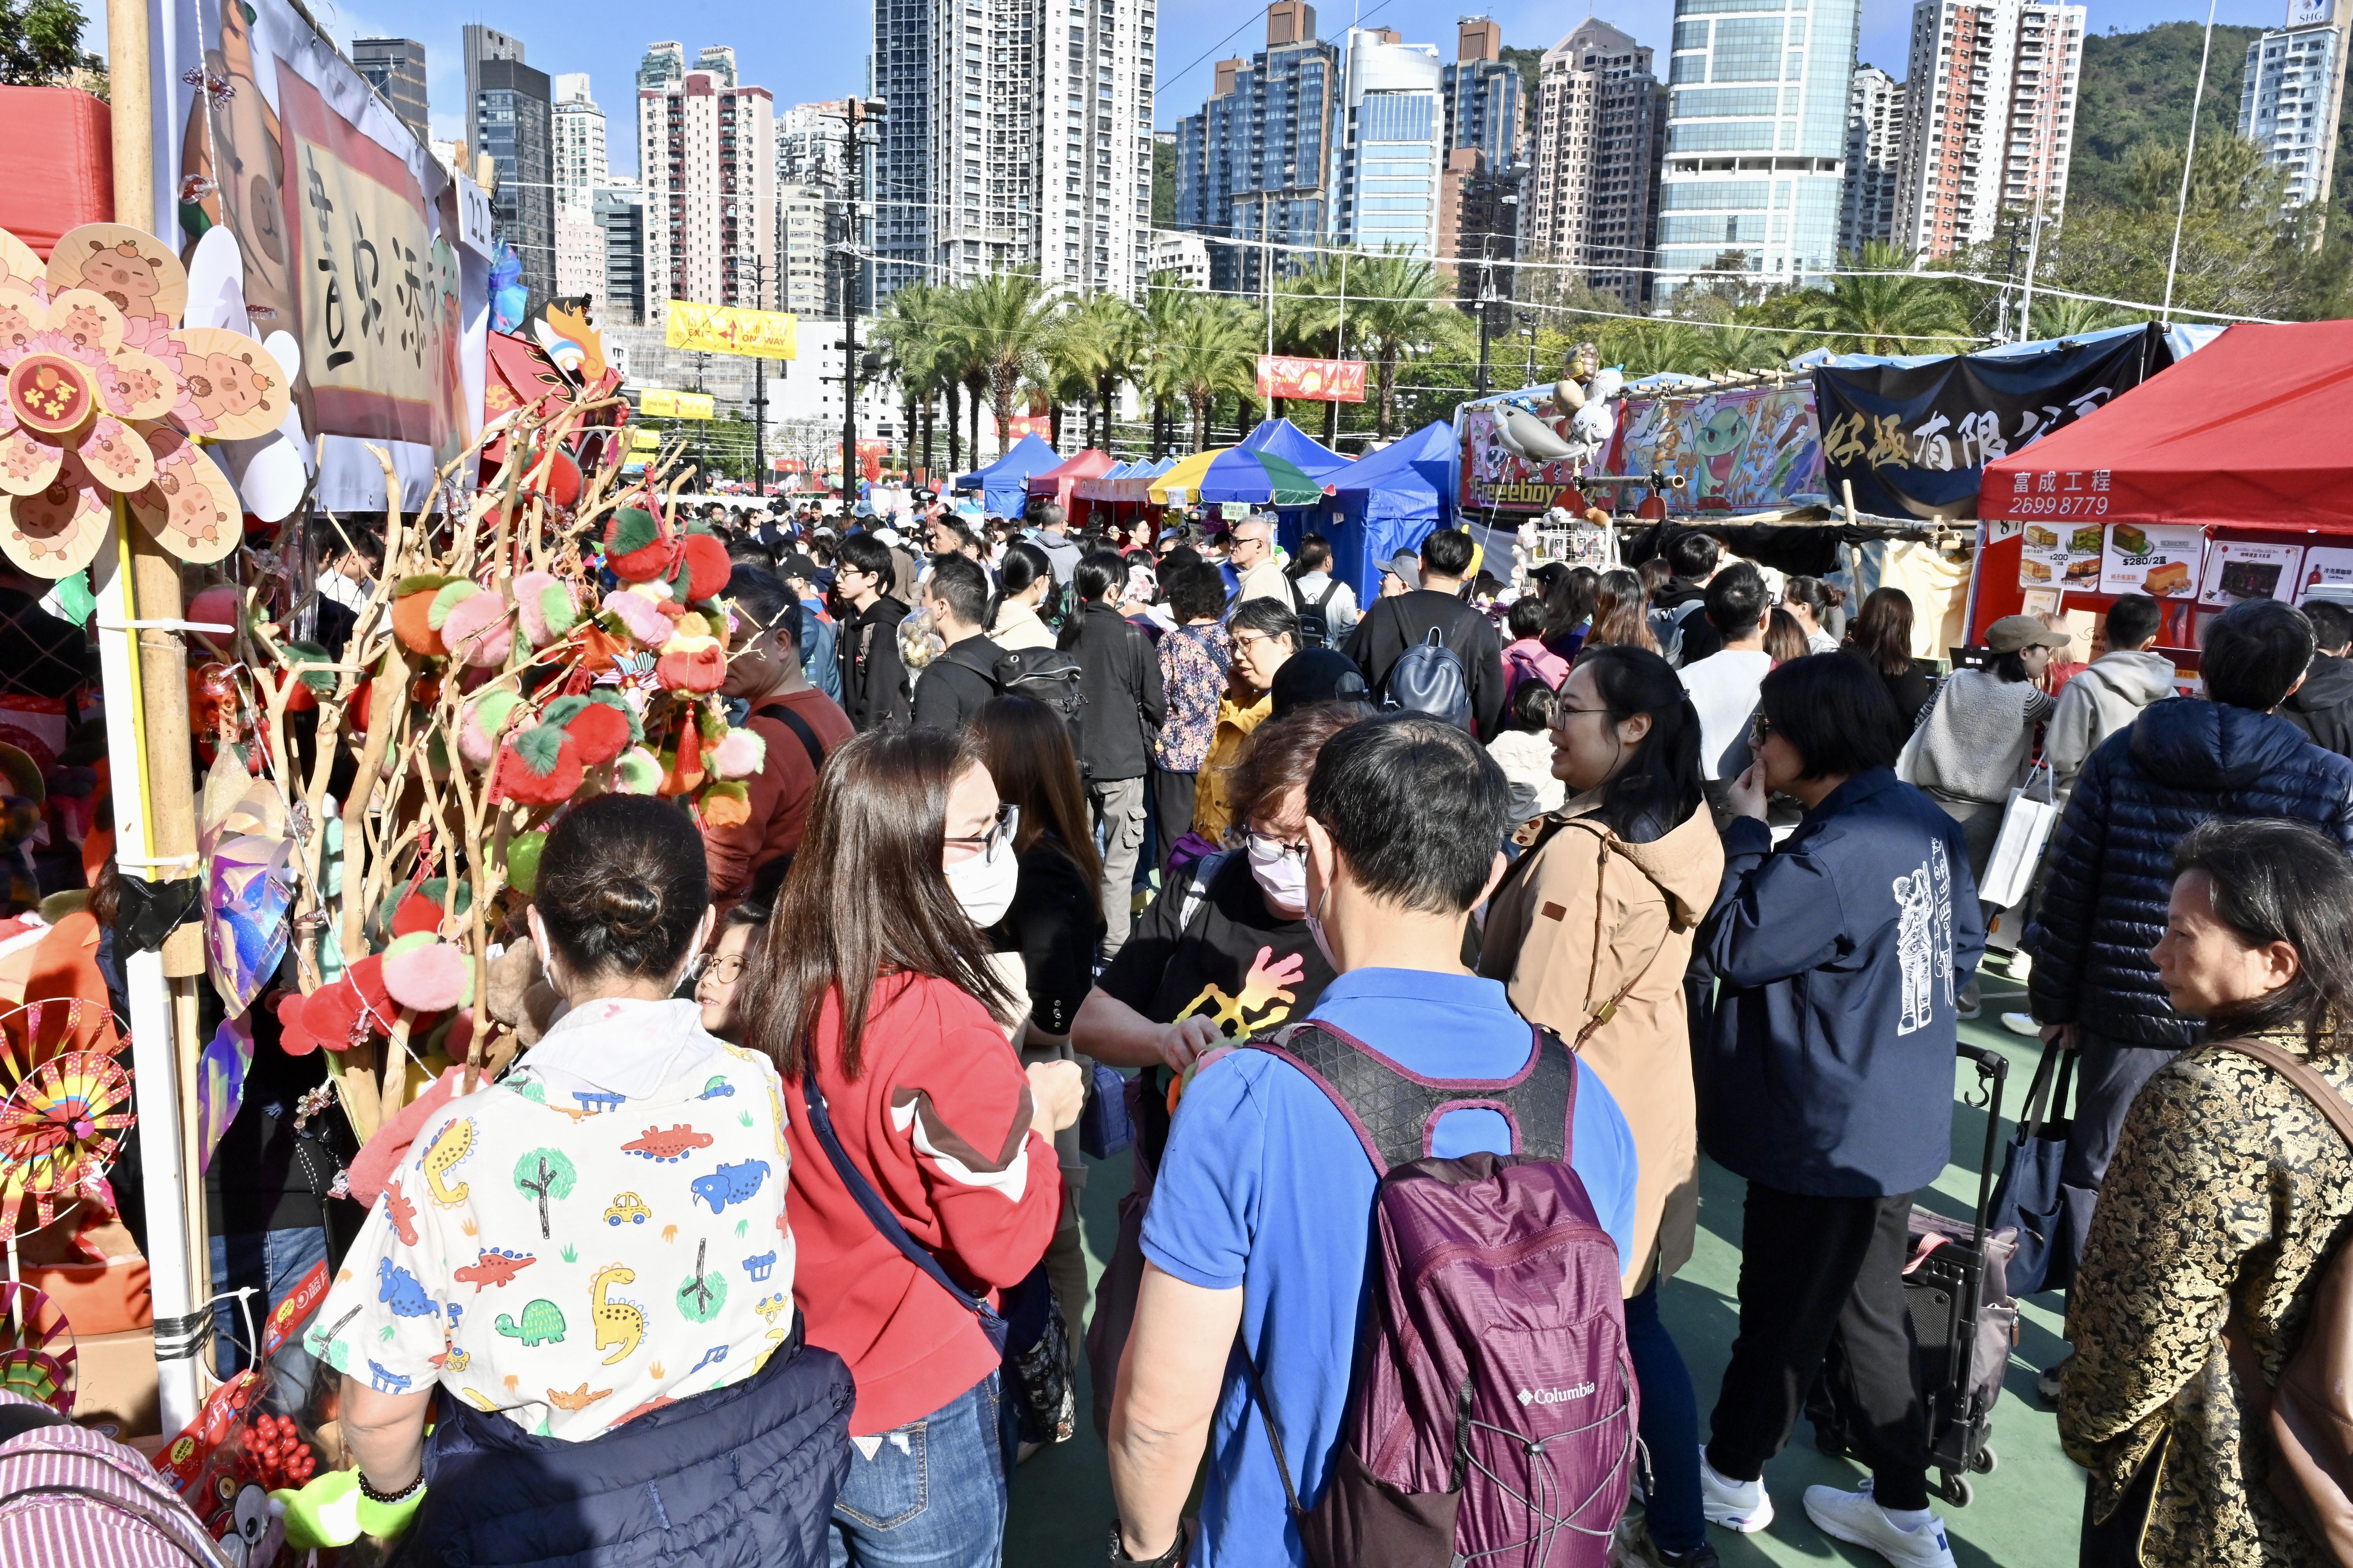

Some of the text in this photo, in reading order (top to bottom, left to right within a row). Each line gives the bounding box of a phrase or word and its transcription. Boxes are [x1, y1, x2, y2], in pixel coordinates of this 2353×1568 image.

[2299, 12, 2322, 23] SHG
[468, 191, 485, 244] 22
[765, 337, 785, 346] WAY
[2014, 469, 2111, 493] 富成工程
[2123, 556, 2167, 566] $280/2盒
[1534, 1381, 1595, 1404] Columbia
